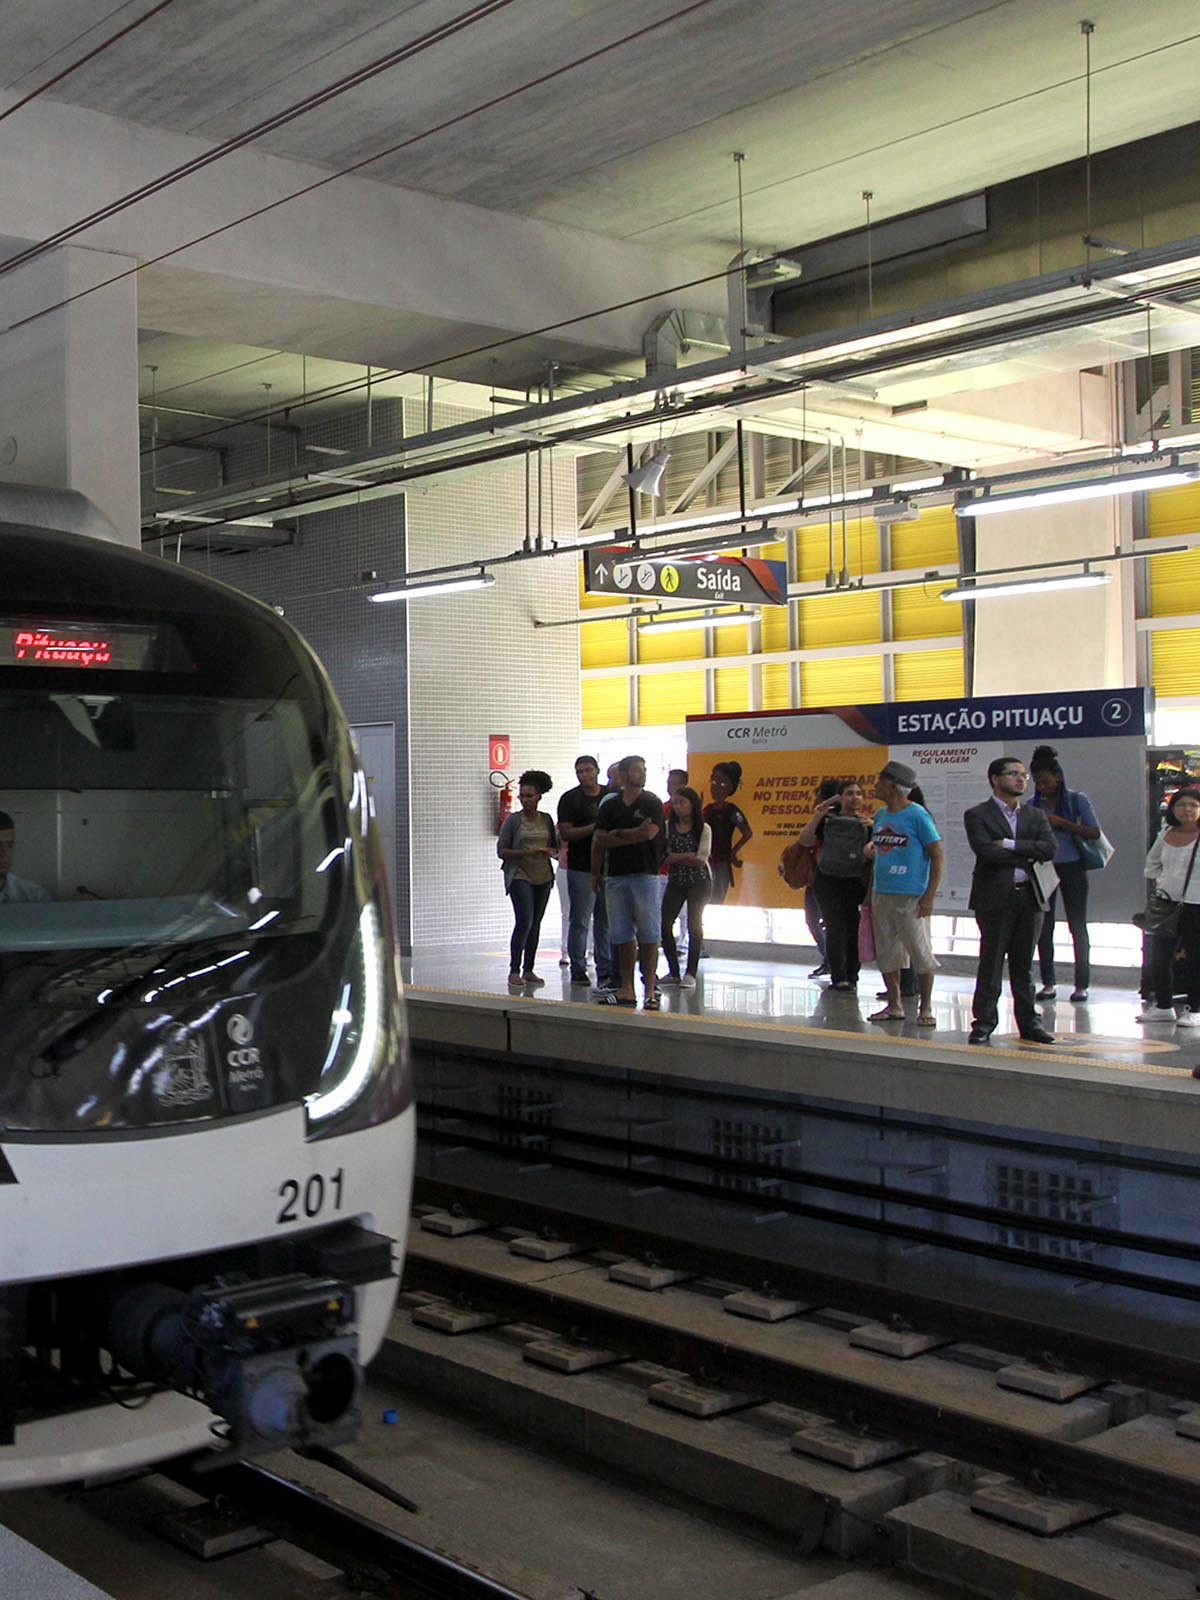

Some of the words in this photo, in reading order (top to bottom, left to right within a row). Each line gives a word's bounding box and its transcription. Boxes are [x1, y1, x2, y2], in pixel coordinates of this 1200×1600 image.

[696, 567, 742, 592] Saída
[897, 707, 986, 734] ESTAÇÃO
[992, 706, 1083, 730] PITUAÇU
[1110, 703, 1122, 720] 2
[726, 727, 751, 739] CCR
[752, 724, 788, 738] Metrô
[911, 747, 978, 758] REGULAMENTO
[919, 757, 933, 765] DE
[935, 756, 970, 764] VIAGEM
[756, 776, 798, 788] ANTES
[801, 776, 819, 787] DE
[753, 790, 772, 801] NO
[775, 790, 812, 802] TREM,
[227, 1047, 261, 1067] CCR
[276, 1166, 344, 1224] 201
